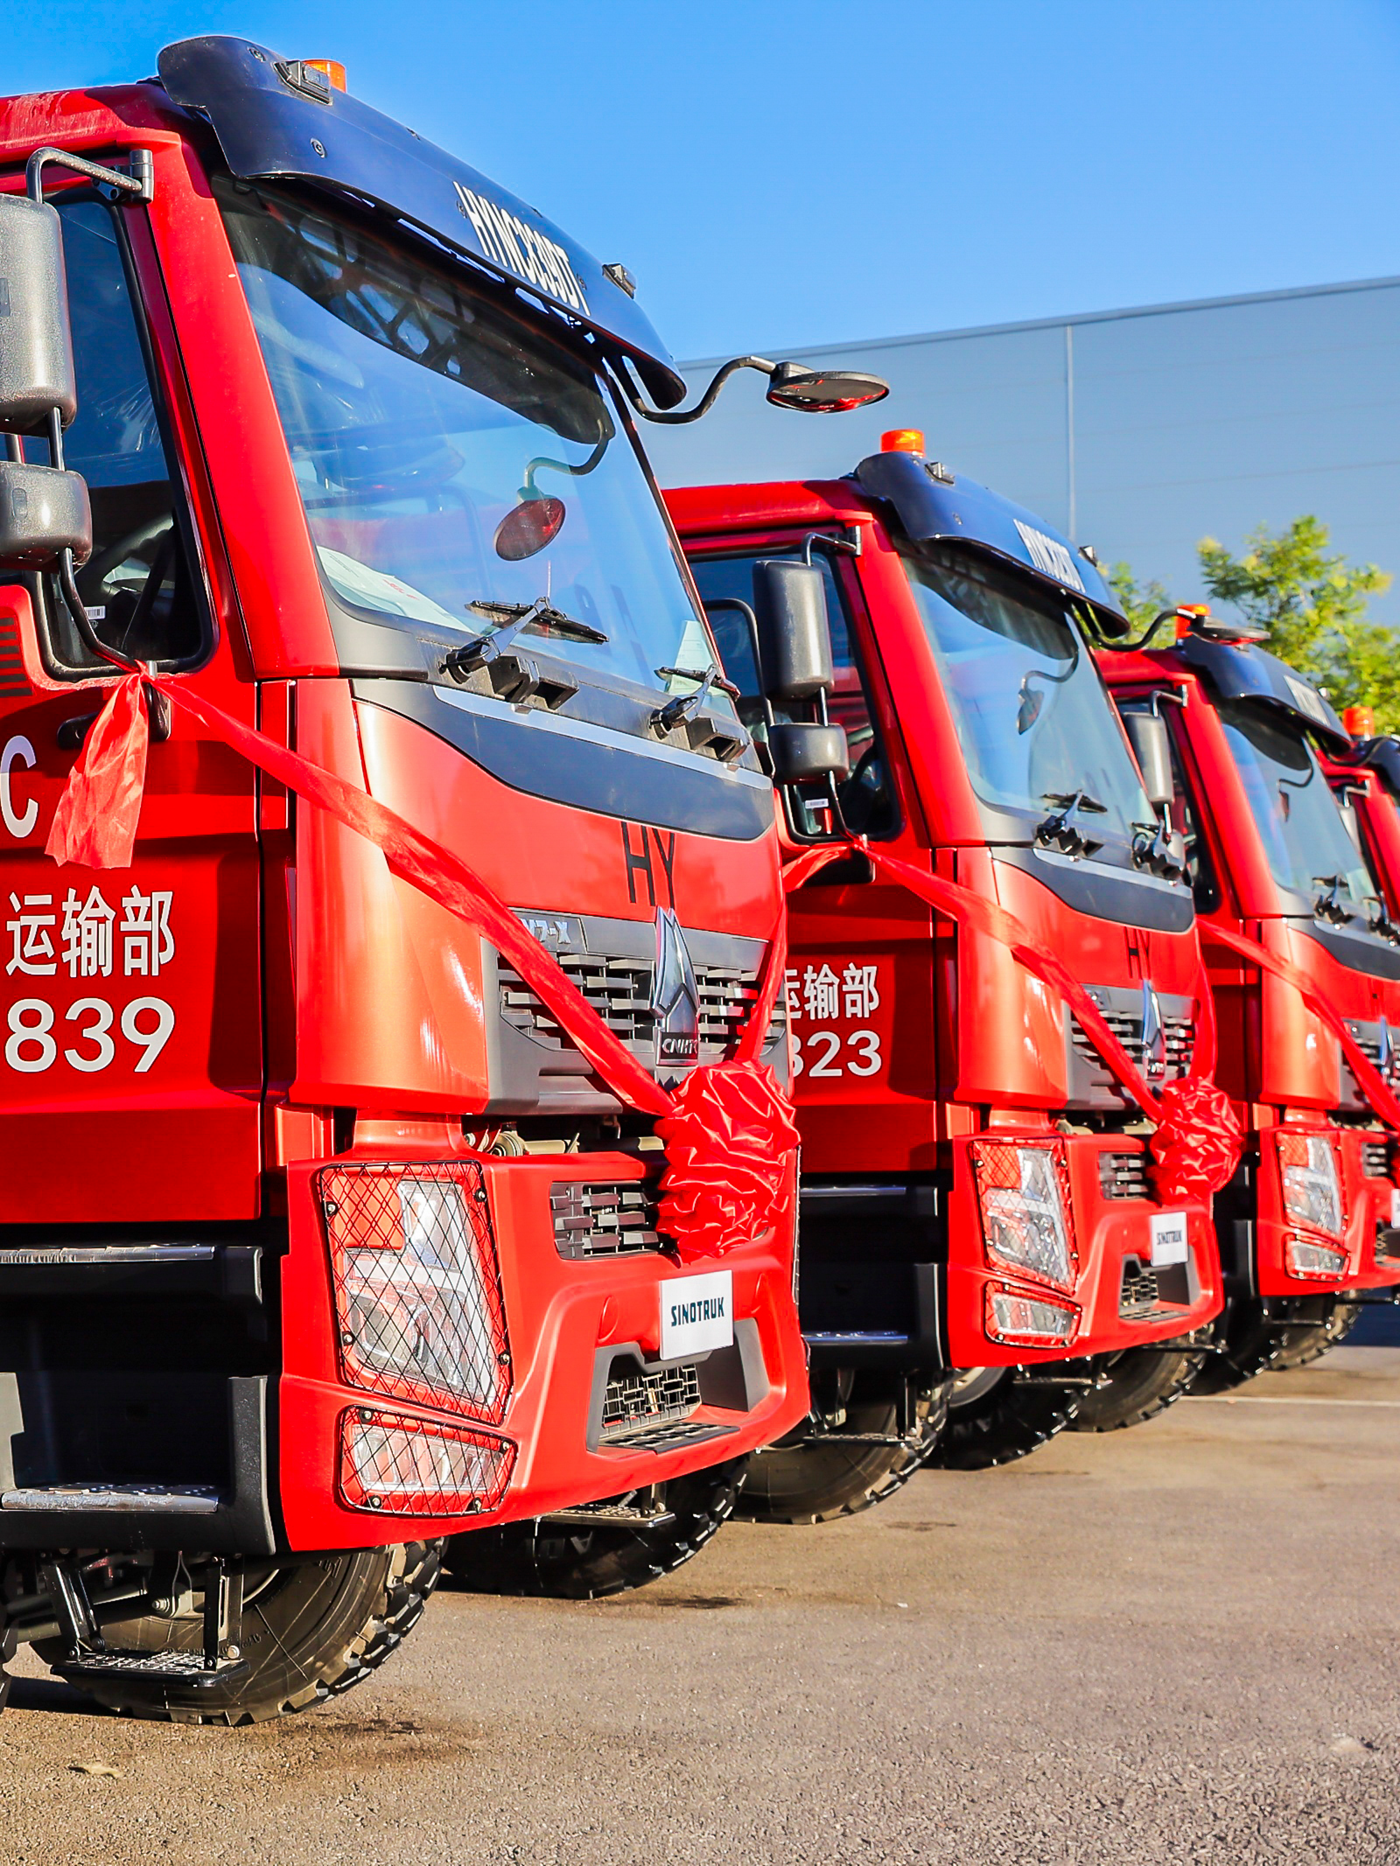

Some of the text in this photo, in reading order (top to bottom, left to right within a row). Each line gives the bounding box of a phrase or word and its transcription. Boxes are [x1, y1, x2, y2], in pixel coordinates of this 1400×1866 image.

[453, 181, 591, 317] HYNC839DT
[620, 821, 676, 909] HY
[5, 885, 175, 978] 运输部
[5, 997, 175, 1073] 839
[670, 1296, 725, 1327] SINOTRUK
